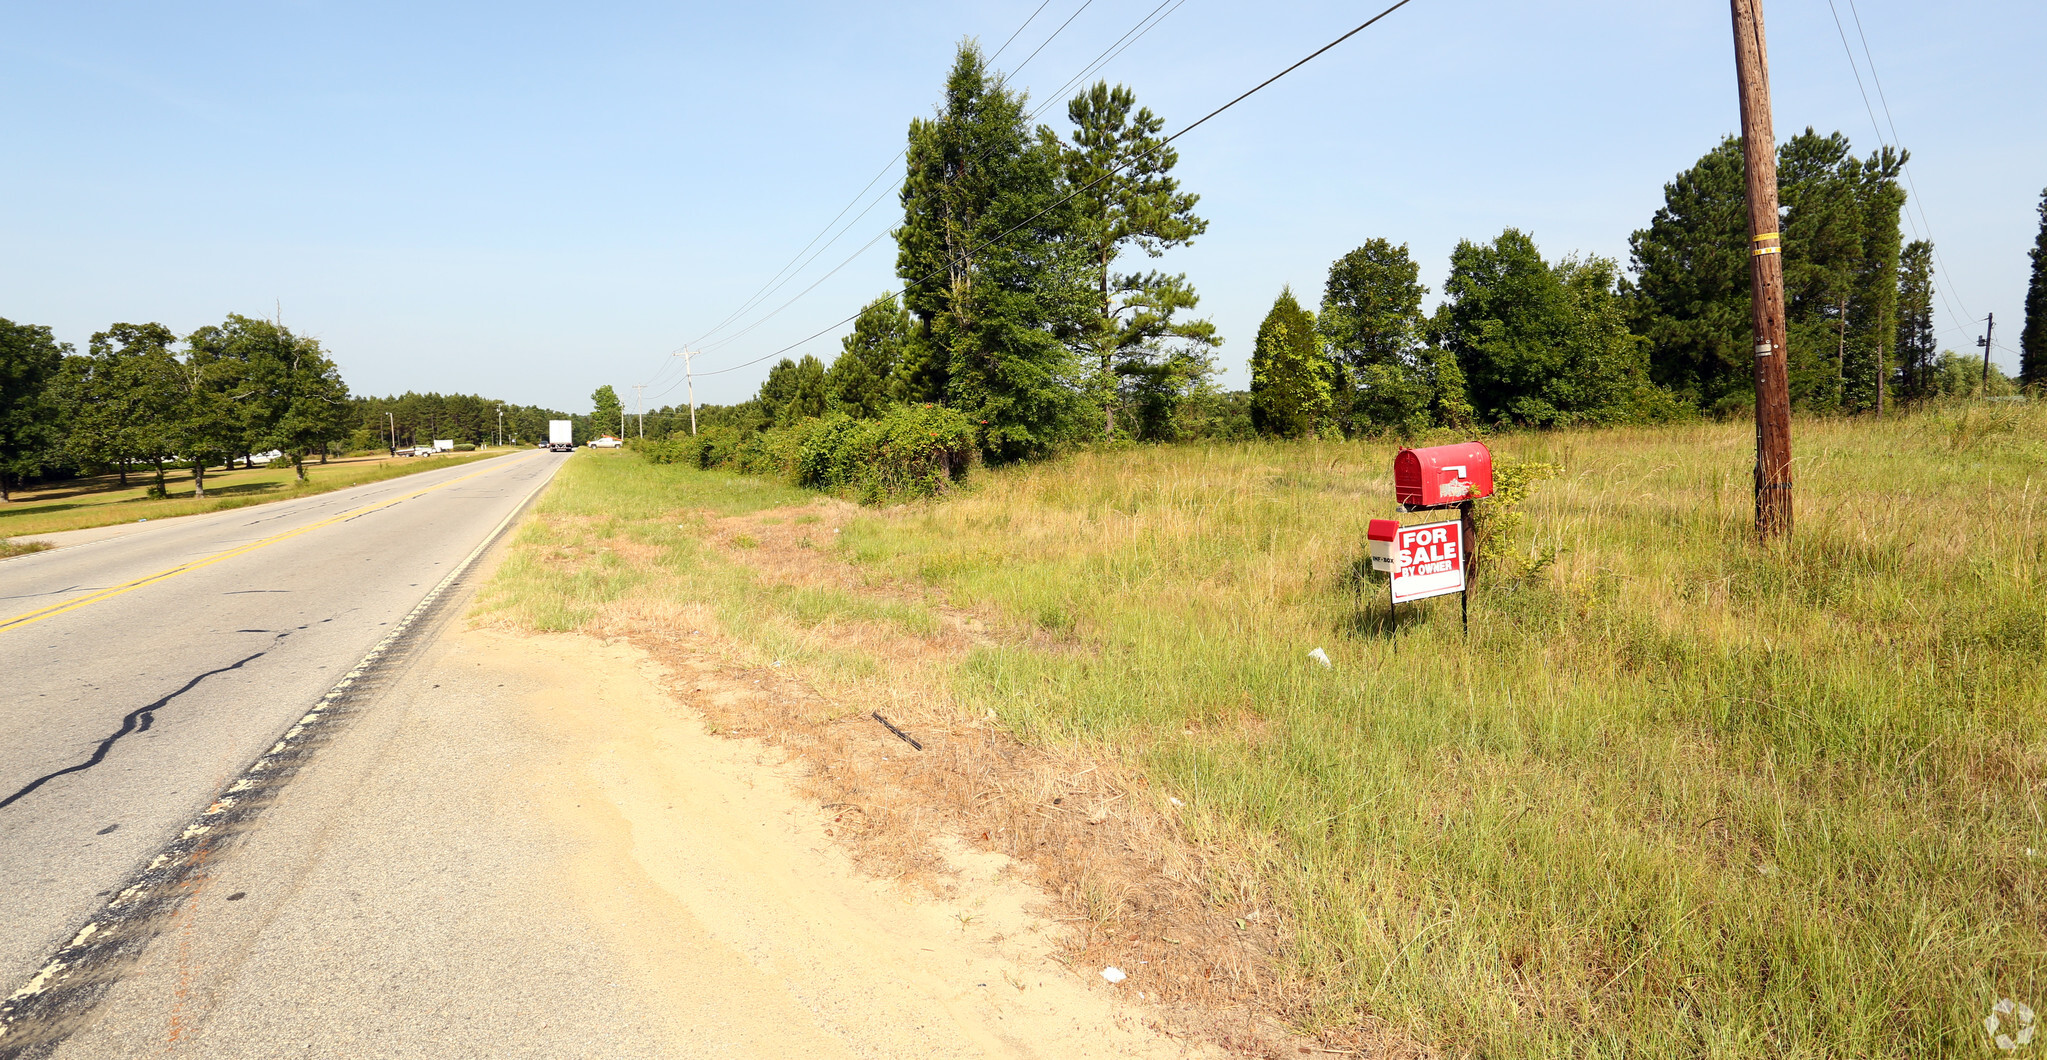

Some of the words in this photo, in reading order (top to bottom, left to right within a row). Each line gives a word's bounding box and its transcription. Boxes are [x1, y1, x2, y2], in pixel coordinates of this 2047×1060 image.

[1403, 528, 1447, 548] FOR
[1400, 542, 1457, 567] SALE
[1402, 566, 1415, 577] BY
[1418, 560, 1452, 575] OWNER
